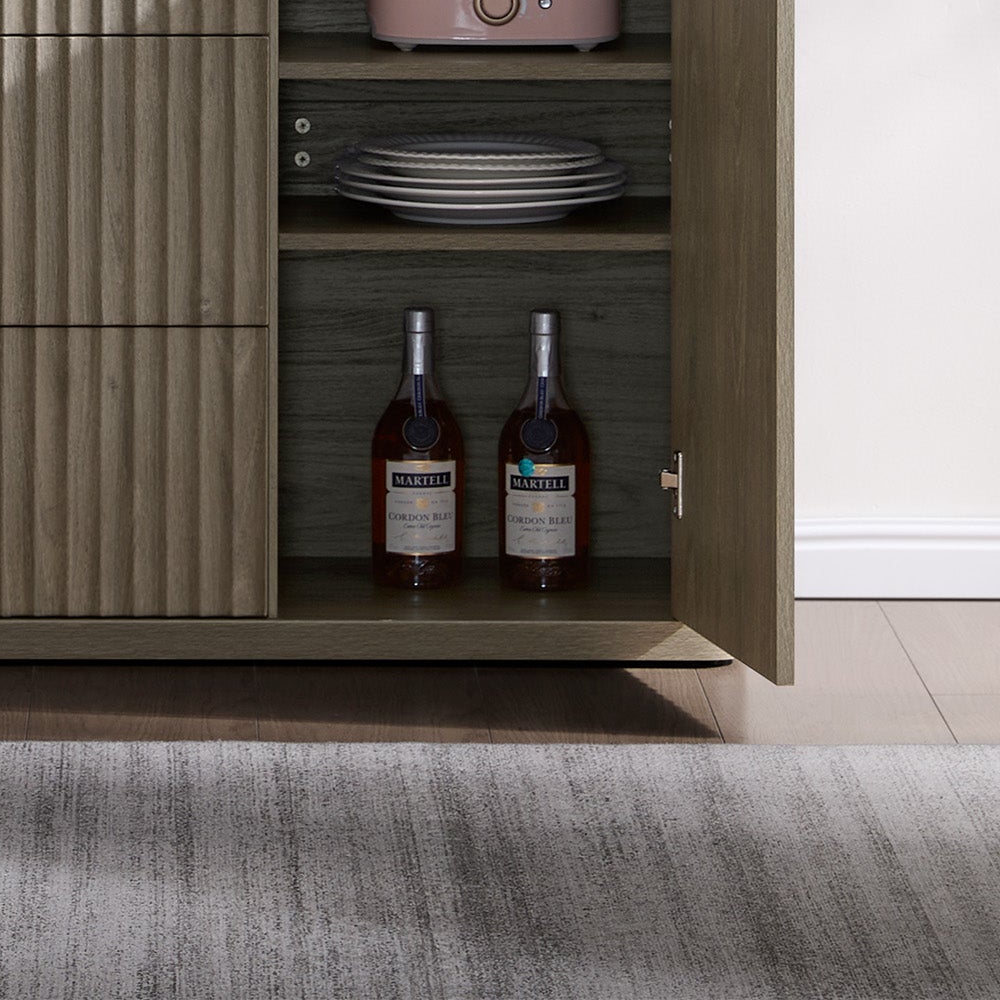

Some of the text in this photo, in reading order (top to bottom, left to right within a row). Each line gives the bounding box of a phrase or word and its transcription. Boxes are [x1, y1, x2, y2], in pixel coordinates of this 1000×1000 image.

[394, 474, 449, 486] MARTELL
[512, 478, 567, 489] MARTELL
[388, 511, 454, 522] CORDON BLEU
[507, 514, 573, 526] CORDON BLEU
